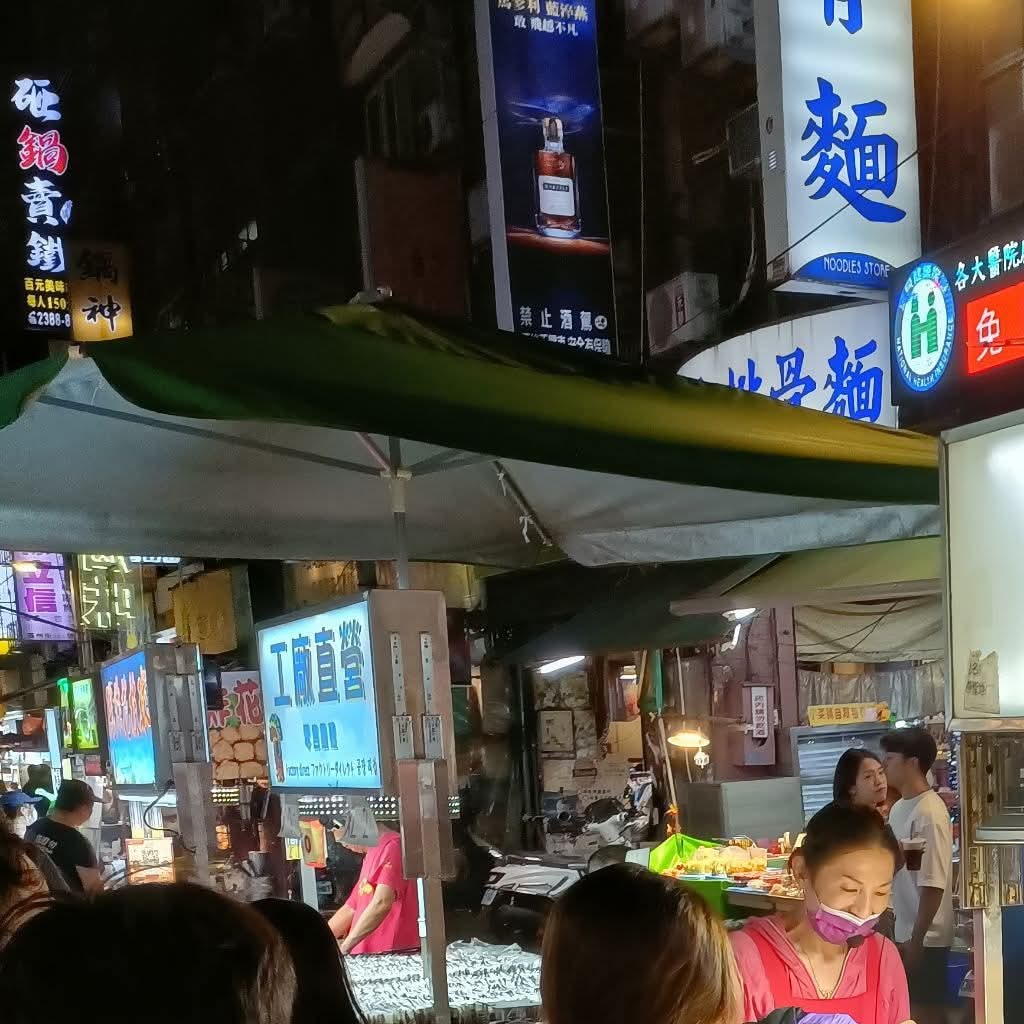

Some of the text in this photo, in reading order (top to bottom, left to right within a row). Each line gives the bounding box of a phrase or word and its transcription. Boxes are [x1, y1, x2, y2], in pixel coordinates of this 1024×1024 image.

[824, 256, 862, 275] NOODLES
[24, 277, 69, 293] 百元美味
